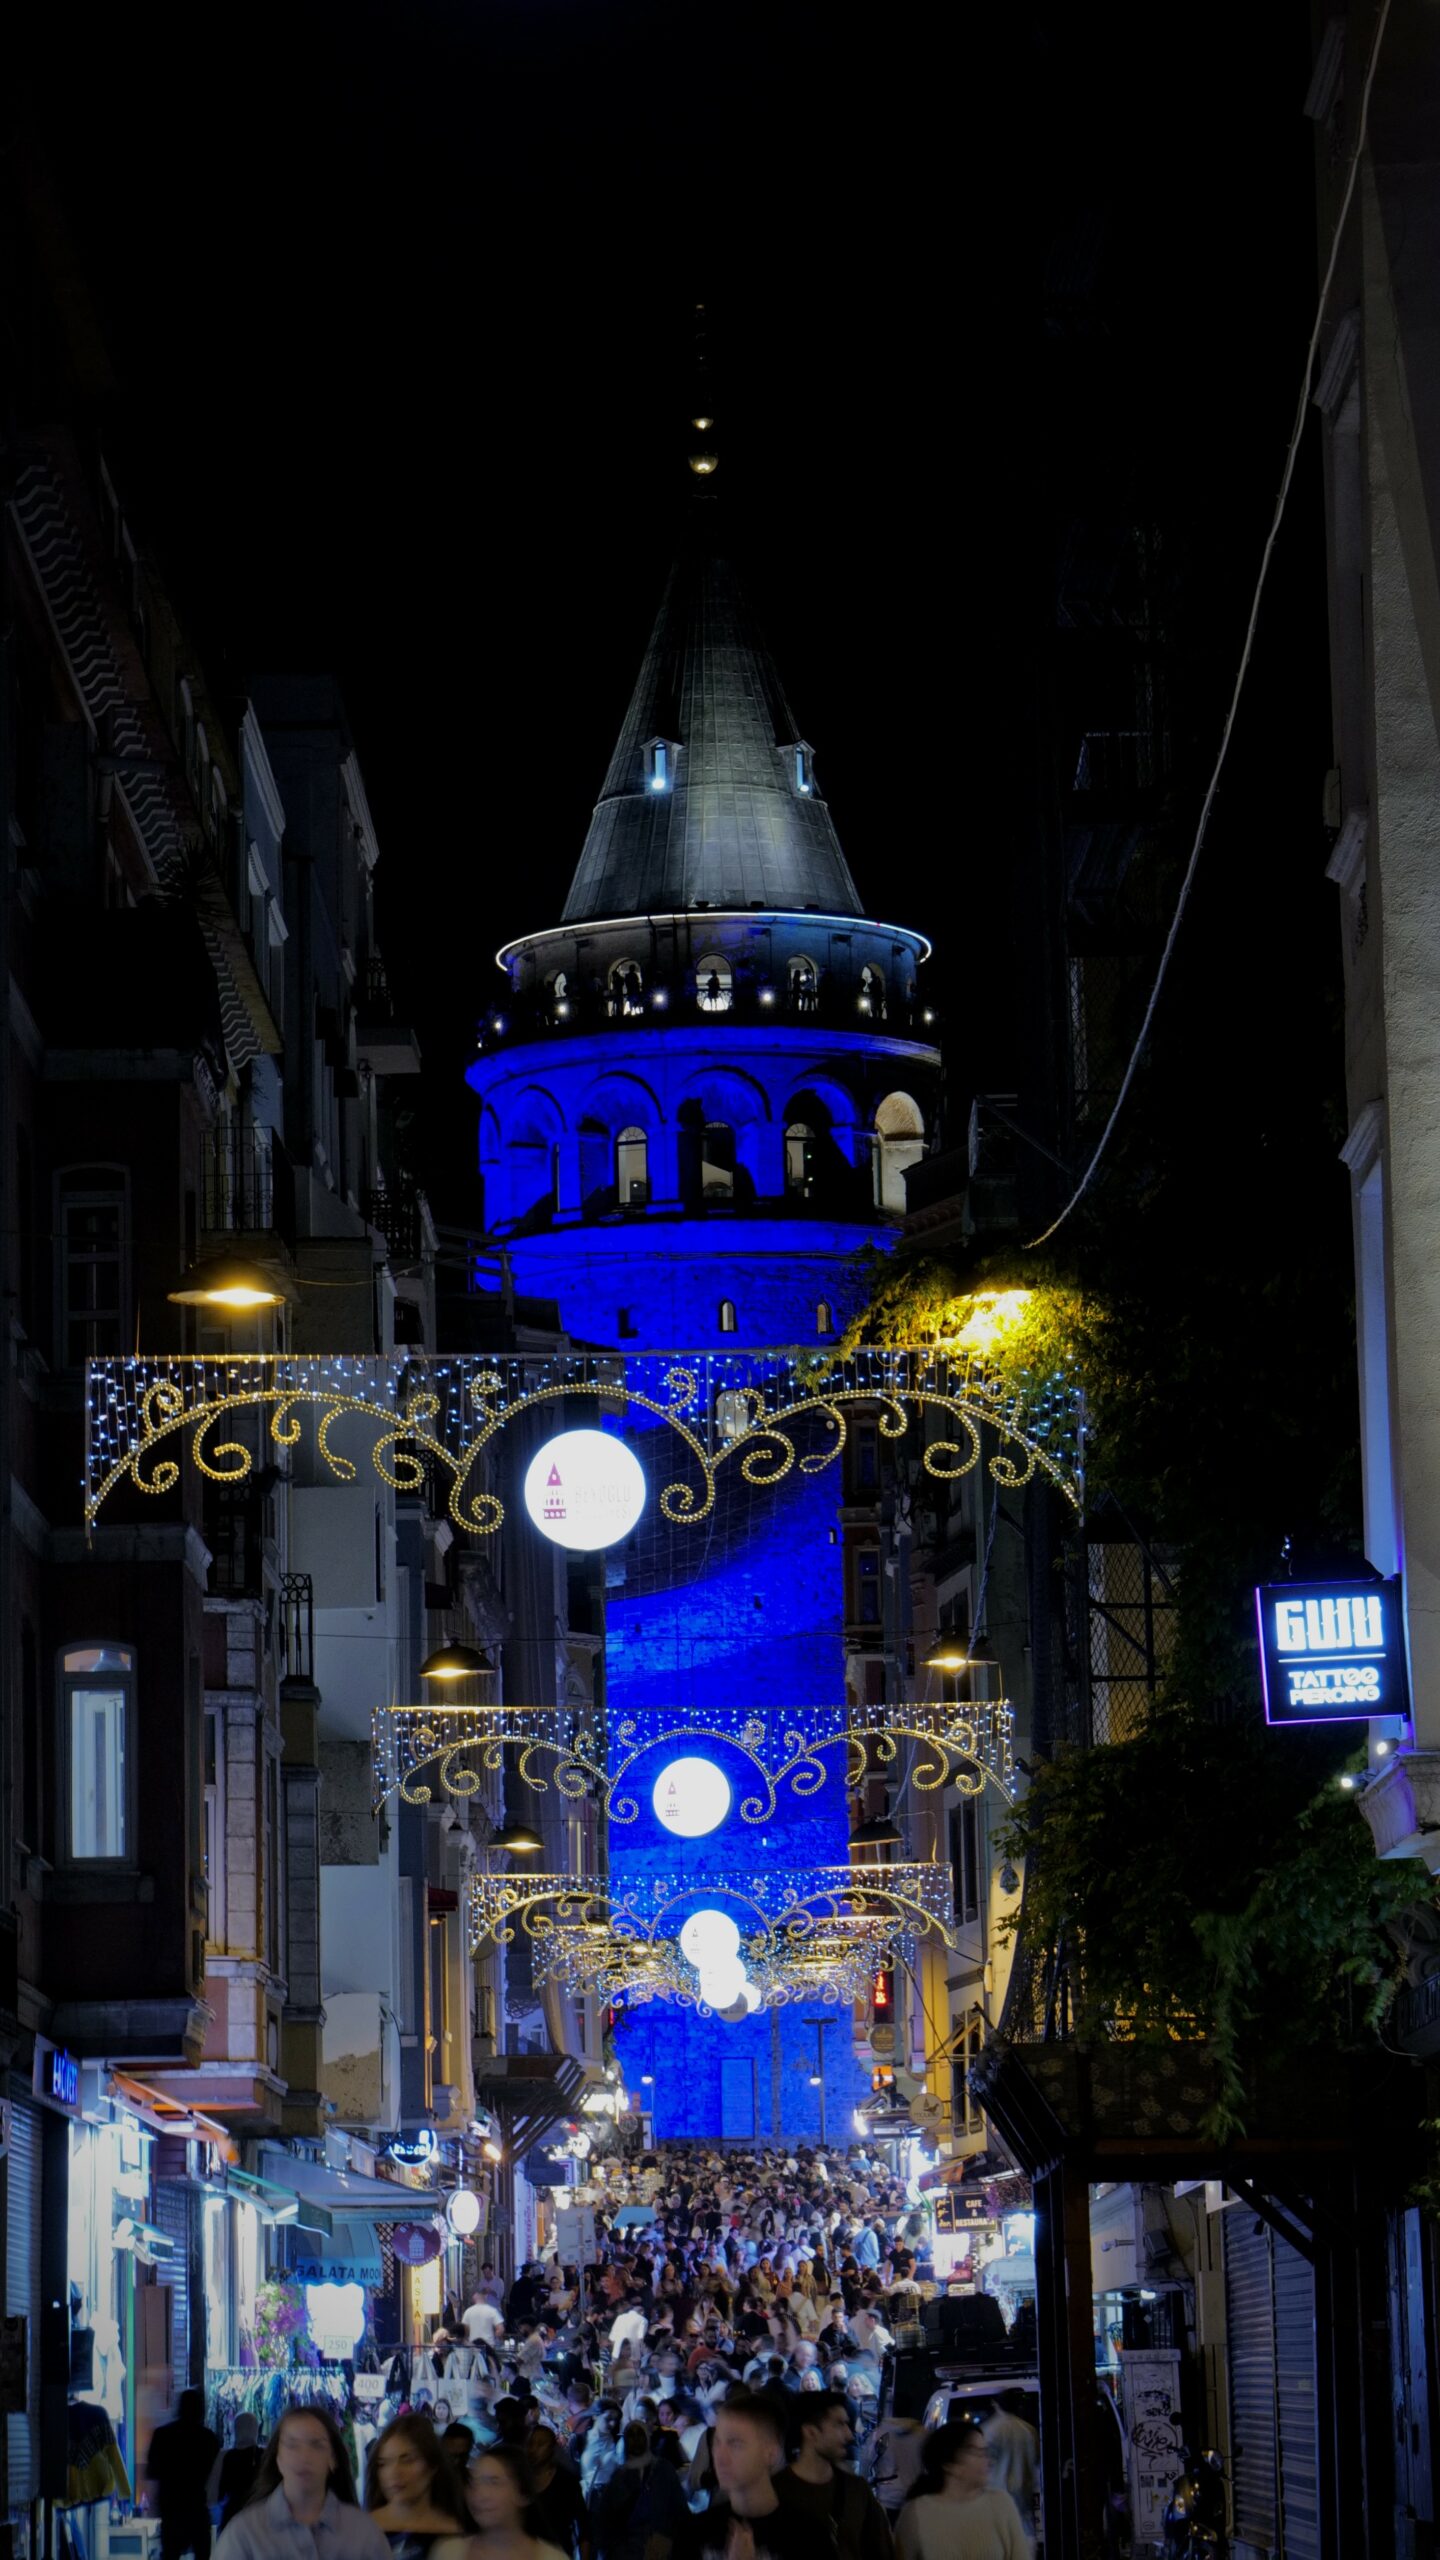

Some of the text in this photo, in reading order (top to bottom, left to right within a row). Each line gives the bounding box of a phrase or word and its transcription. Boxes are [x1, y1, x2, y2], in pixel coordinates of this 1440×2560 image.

[1288, 1667, 1379, 1689] TATTOO
[965, 2200, 983, 2208] CAFE
[296, 2265, 356, 2280] GALATA
[328, 2339, 348, 2350] 250
[358, 2378, 379, 2390] 400
